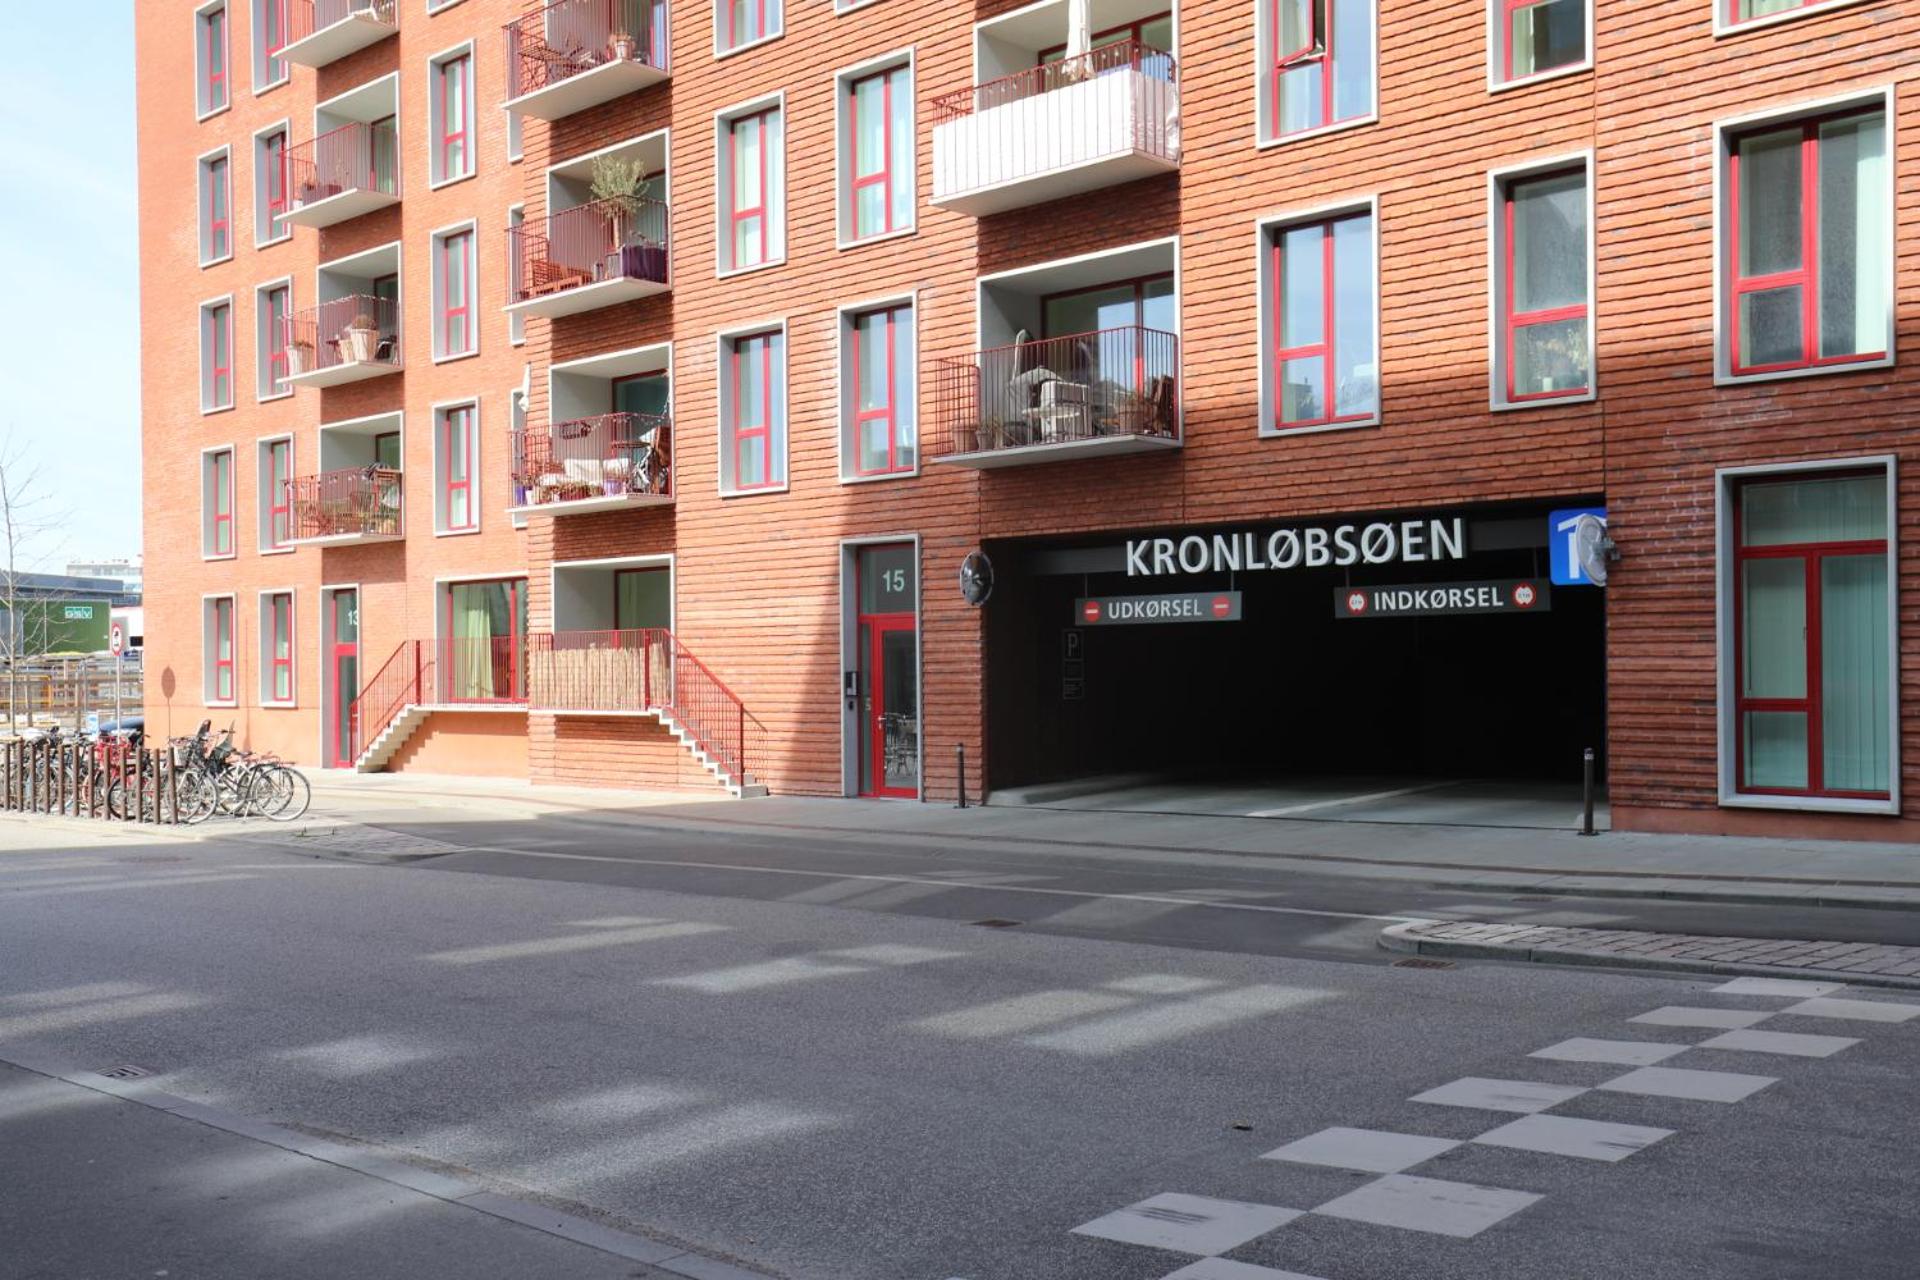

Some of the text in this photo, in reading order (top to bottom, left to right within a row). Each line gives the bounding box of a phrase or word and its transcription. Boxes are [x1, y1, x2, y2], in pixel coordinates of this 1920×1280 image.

[1126, 518, 1464, 576] KRONLØBSØEN
[883, 569, 904, 592] 15
[1108, 599, 1203, 619] UDKØRSEL
[1374, 587, 1504, 611] INDKØRSEL
